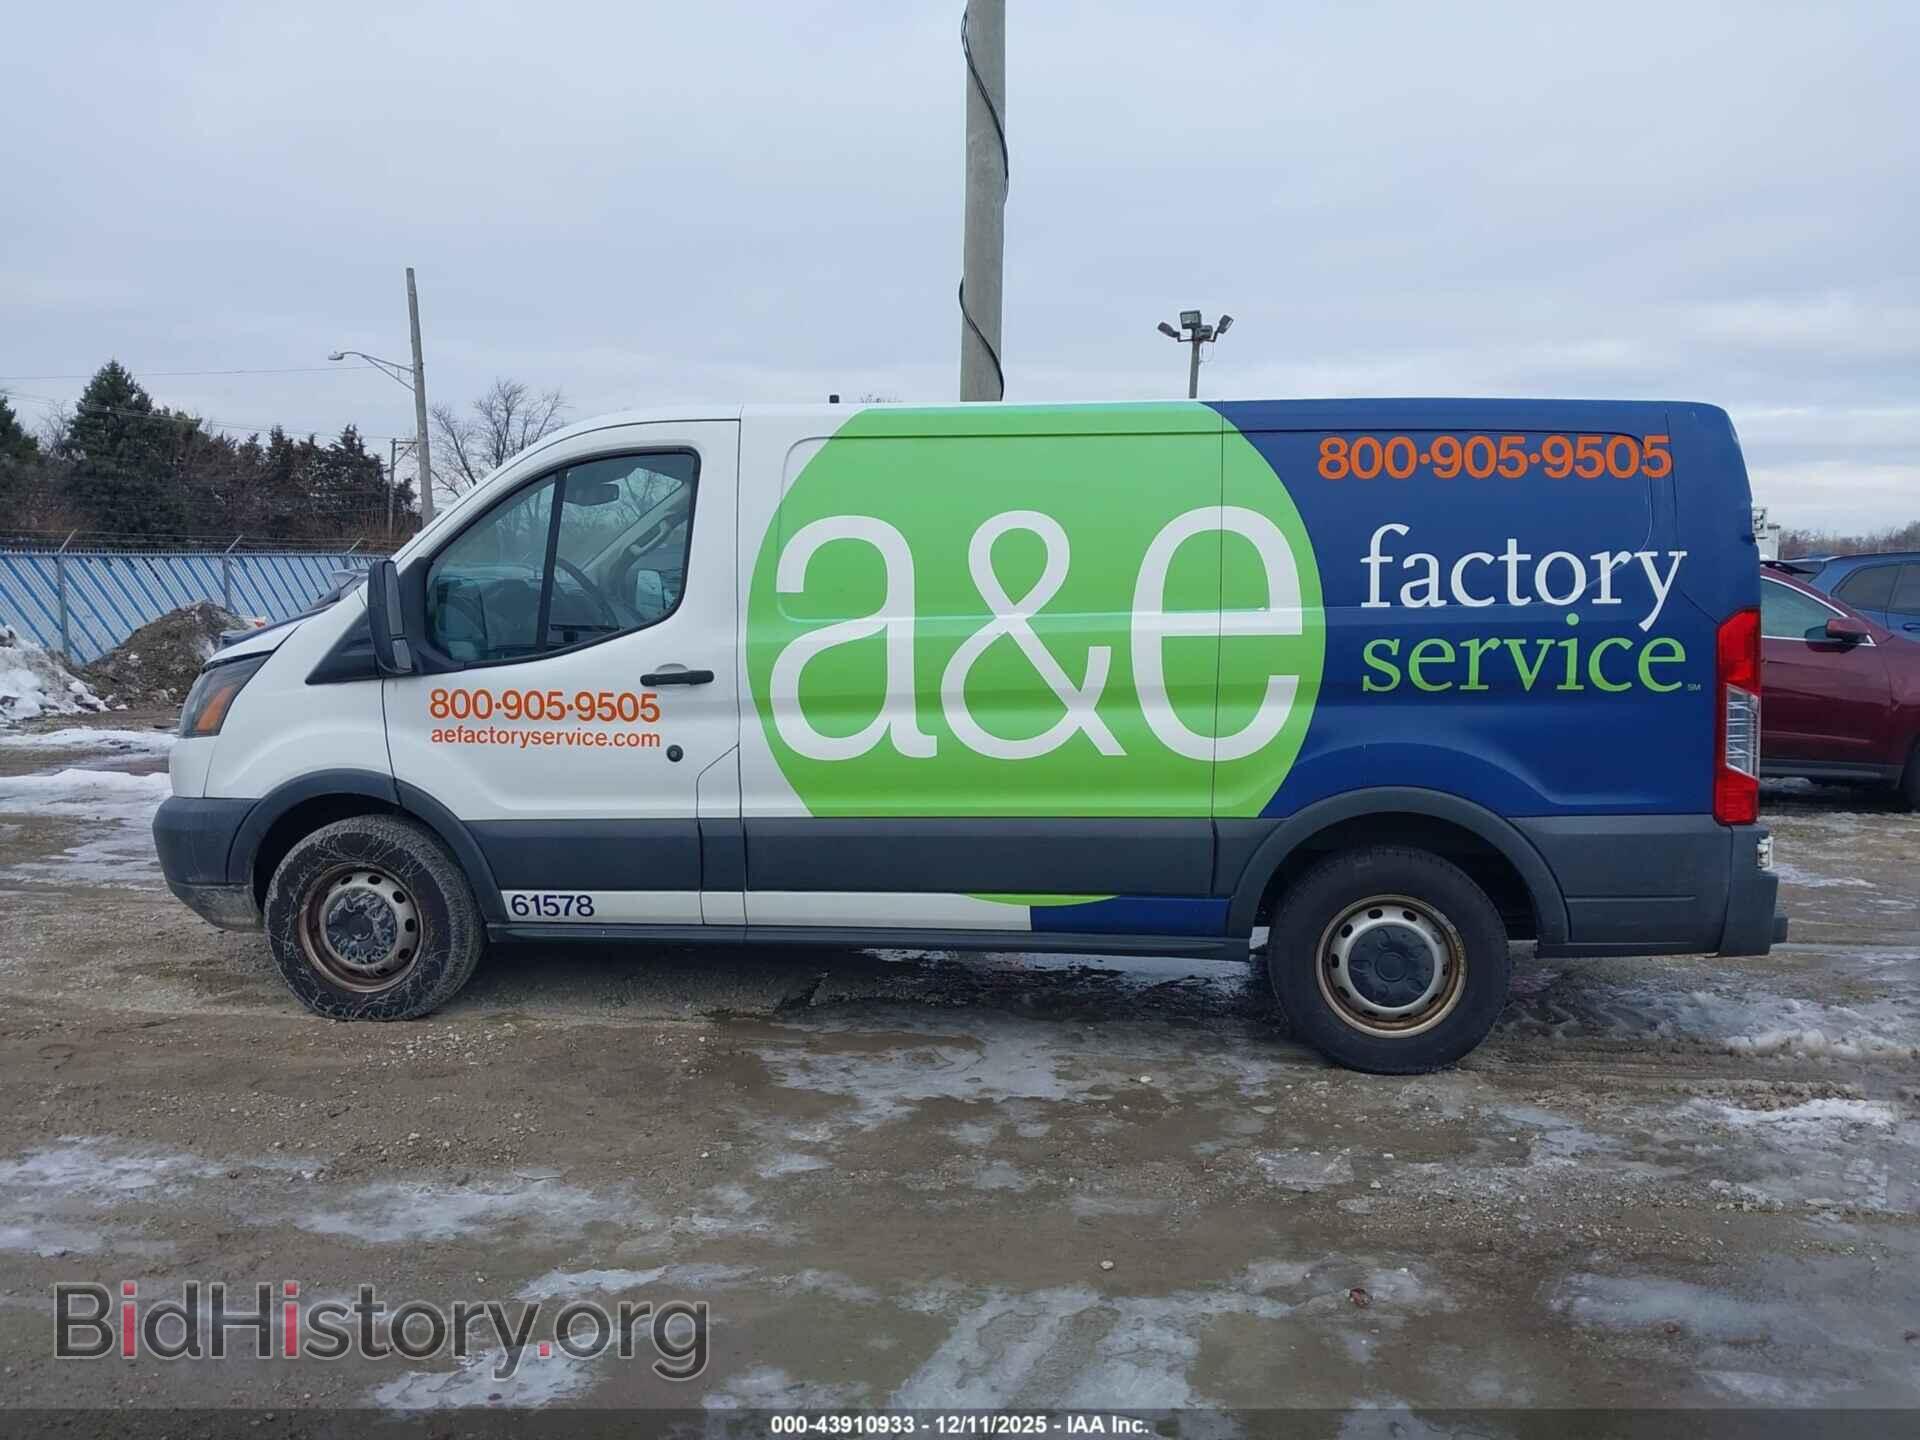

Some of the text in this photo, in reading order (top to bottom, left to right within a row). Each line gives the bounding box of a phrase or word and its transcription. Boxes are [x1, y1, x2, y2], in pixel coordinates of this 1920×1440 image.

[1360, 523, 1688, 633] factory
[769, 505, 1303, 762] a&e
[1362, 613, 1686, 692] service
[431, 725, 661, 749] aefactoryservice.com
[511, 894, 595, 917] 61578
